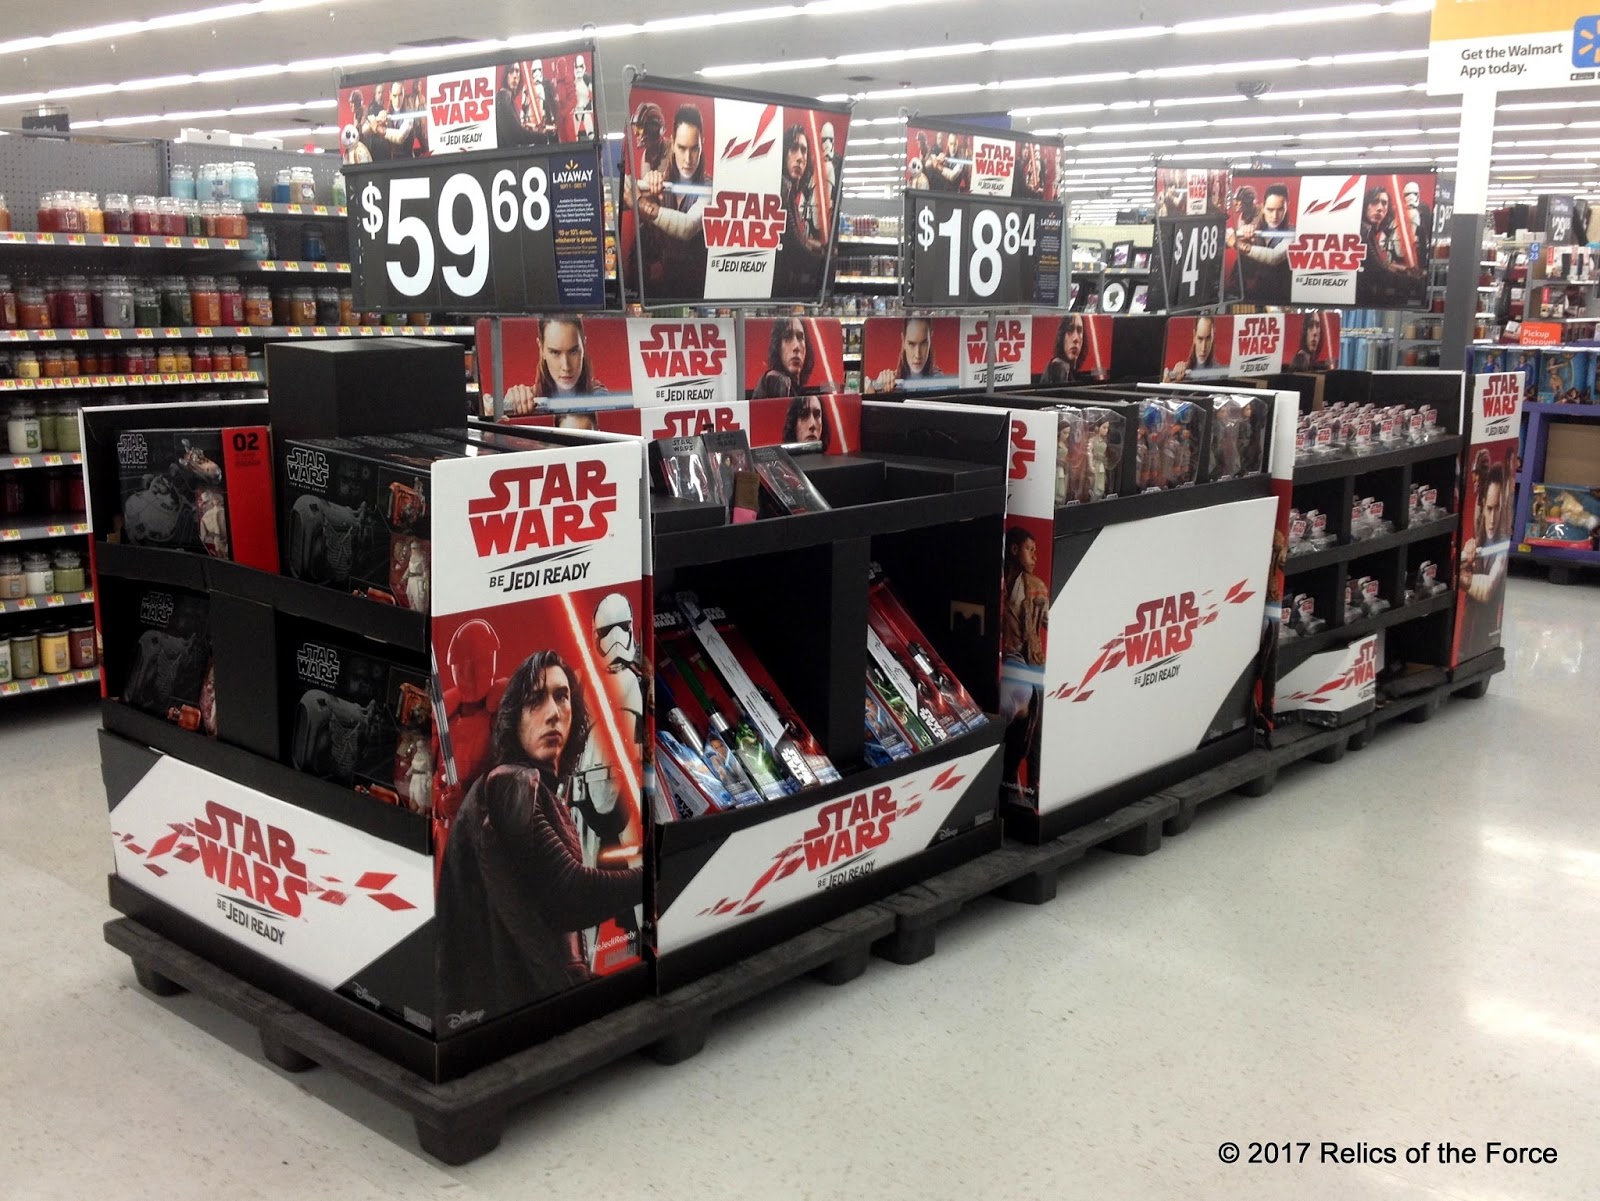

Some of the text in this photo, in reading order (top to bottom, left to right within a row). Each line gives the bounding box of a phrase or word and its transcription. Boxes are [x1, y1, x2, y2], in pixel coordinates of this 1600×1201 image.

[1461, 43, 1563, 61] Get the Walmart
[1460, 62, 1527, 78] App today.
[431, 77, 493, 103] STAR
[431, 99, 493, 126] WARS
[446, 133, 461, 146] JEDI
[462, 132, 483, 143] READY
[976, 143, 1014, 162] STAR
[553, 169, 594, 184] LAYAWAY
[976, 159, 1013, 177] WARS
[704, 191, 786, 220] STAR
[704, 219, 785, 248] WARS
[1289, 234, 1366, 252] STAR
[711, 259, 767, 272] BE JEDI READY
[1289, 251, 1365, 270] WARS
[1302, 277, 1321, 286] JEDI
[1322, 278, 1349, 287] READY
[640, 323, 726, 350] STAR
[1239, 317, 1280, 336] STAR
[1523, 329, 1550, 338] Pickup
[1239, 336, 1279, 356] WARS
[641, 350, 727, 378] WARS
[665, 389, 686, 402] JEDI
[687, 389, 714, 401] READY
[1483, 374, 1519, 396] STAR
[1483, 395, 1518, 417] WARS
[653, 407, 740, 440] STAR
[117, 434, 147, 449] STAR
[233, 433, 259, 451] 02
[117, 448, 148, 464] WARS
[287, 447, 329, 471] STAR
[287, 462, 329, 487] WARS
[469, 459, 616, 514] STAR
[469, 499, 616, 557] WARS
[489, 561, 591, 592] BE JEDI READY
[141, 604, 173, 623] WARS
[1125, 591, 1199, 636] STAR
[1125, 617, 1198, 667] WARS
[297, 643, 340, 668] STAR
[297, 657, 340, 683] WARS
[1134, 664, 1181, 688] BE JEDI READY
[804, 786, 896, 842] STAR
[194, 800, 307, 878] STAR
[804, 814, 896, 872] WARS
[198, 838, 308, 918] WARS
[817, 860, 875, 890] BE JEDI READY
[217, 899, 286, 945] BE JEDI READY
